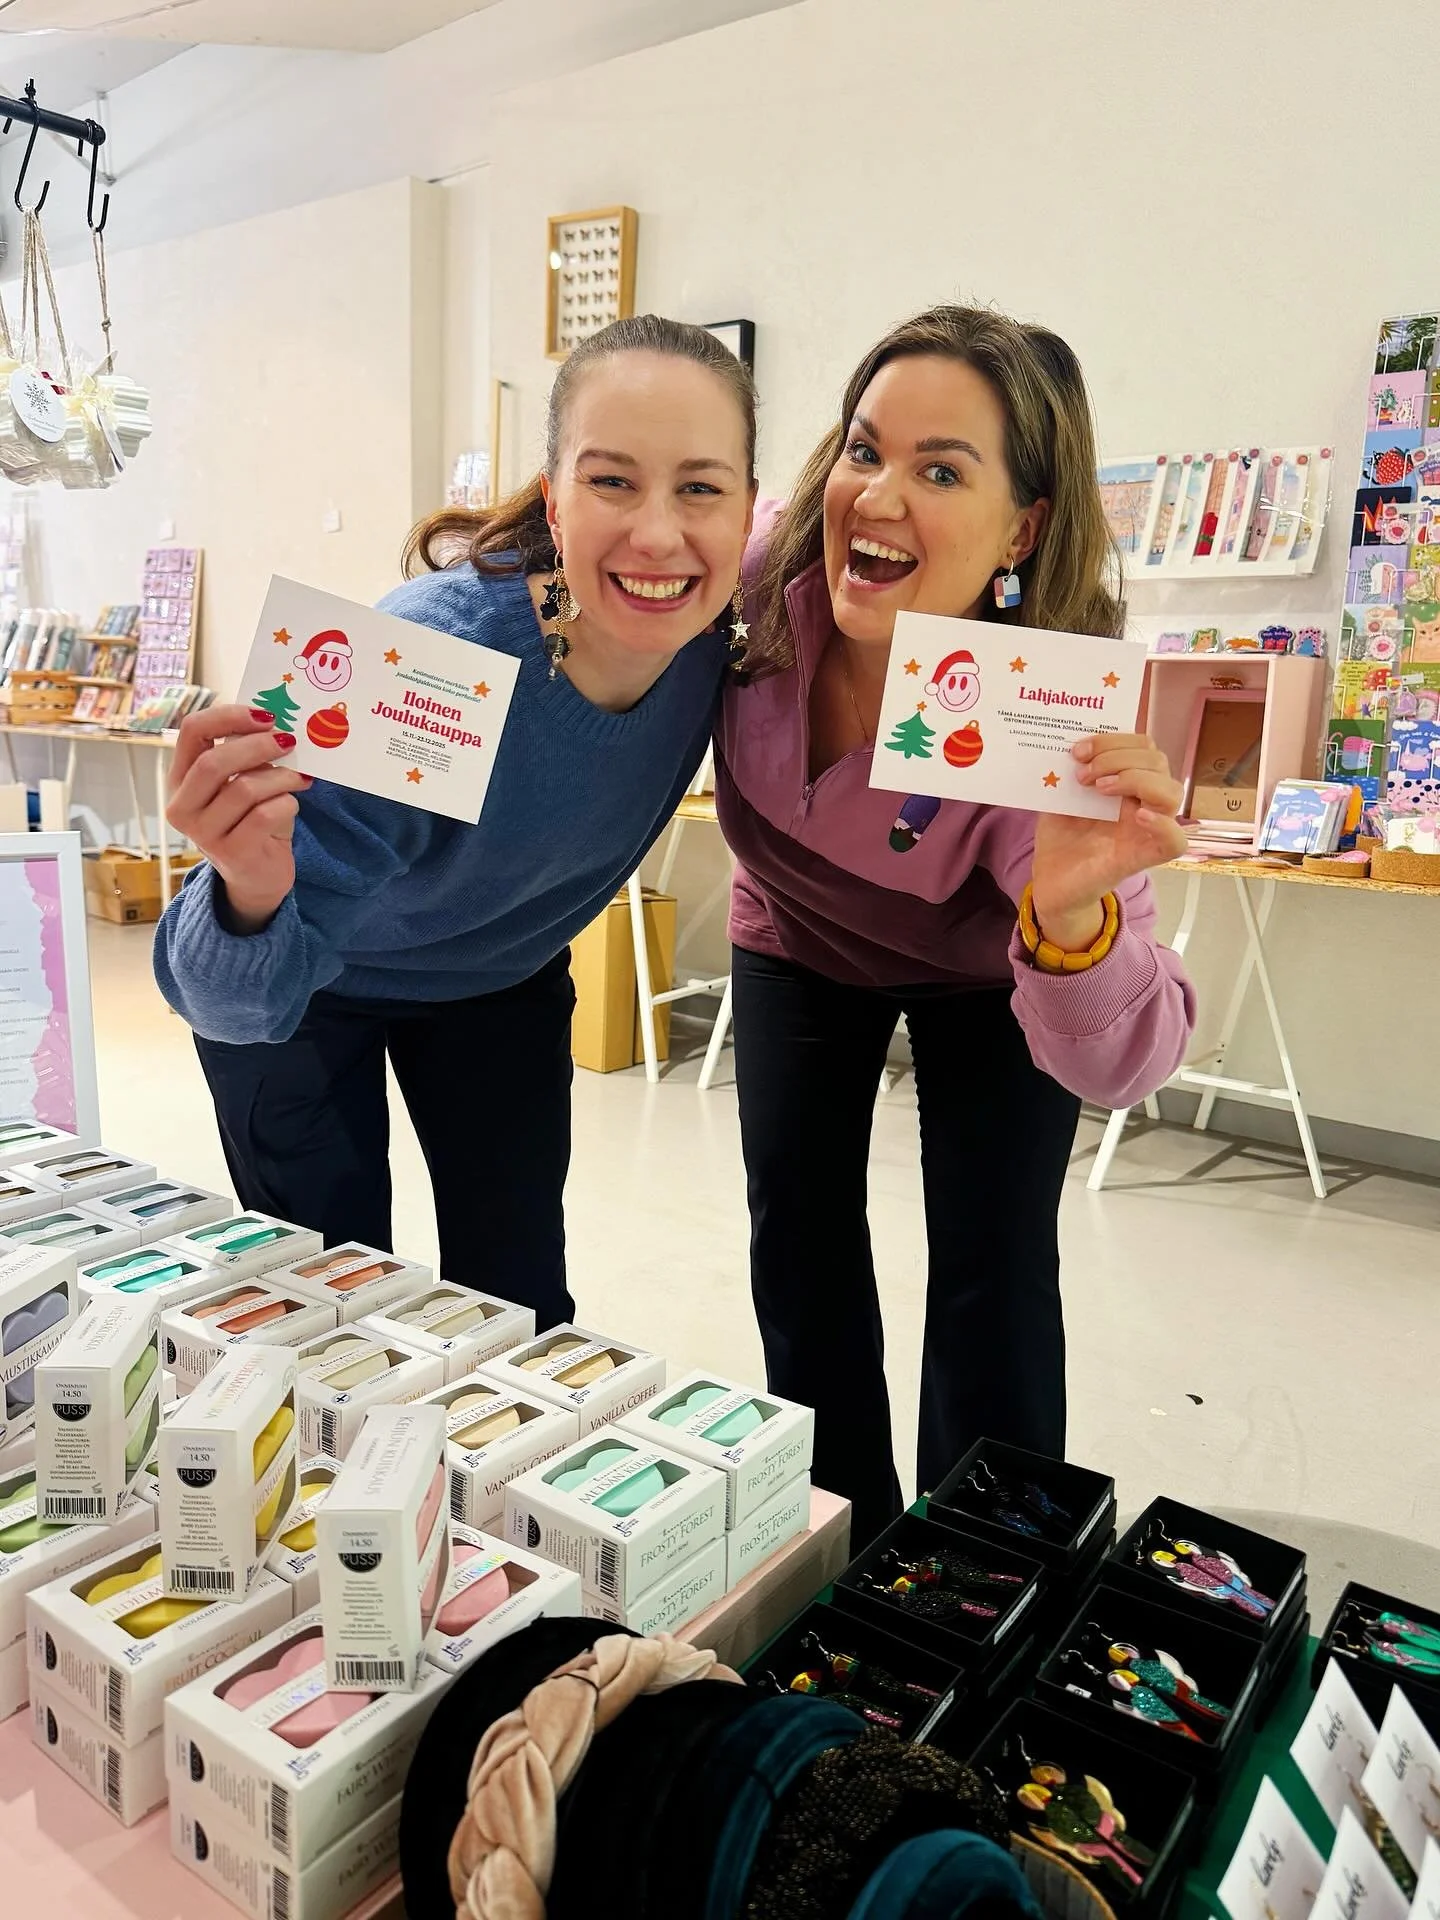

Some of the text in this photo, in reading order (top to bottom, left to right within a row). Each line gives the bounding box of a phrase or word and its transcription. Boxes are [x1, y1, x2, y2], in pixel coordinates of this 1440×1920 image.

[402, 690, 462, 722] Iloinen
[1019, 686, 1105, 710] Lahjakortti
[371, 701, 483, 748] Joulukauppa
[541, 1344, 607, 1377] VANILJAKAHVI
[55, 1404, 89, 1416] PUSSI
[61, 1390, 82, 1398] 14.50
[590, 1384, 658, 1432] VANILLA COFFEE
[190, 1454, 210, 1462] 14.50
[747, 1463, 778, 1493] FROSTY
[778, 1438, 806, 1469] FOREST
[180, 1469, 214, 1481] PUSSI
[350, 1539, 372, 1547] 14.50
[640, 1534, 678, 1568] FROSTY
[679, 1504, 715, 1538] FOREST
[739, 1527, 771, 1559] FROSTY
[772, 1503, 802, 1533] FOREST
[343, 1553, 381, 1566] PUSSI
[641, 1602, 677, 1635] FROSTY
[679, 1569, 715, 1605] FOREST
